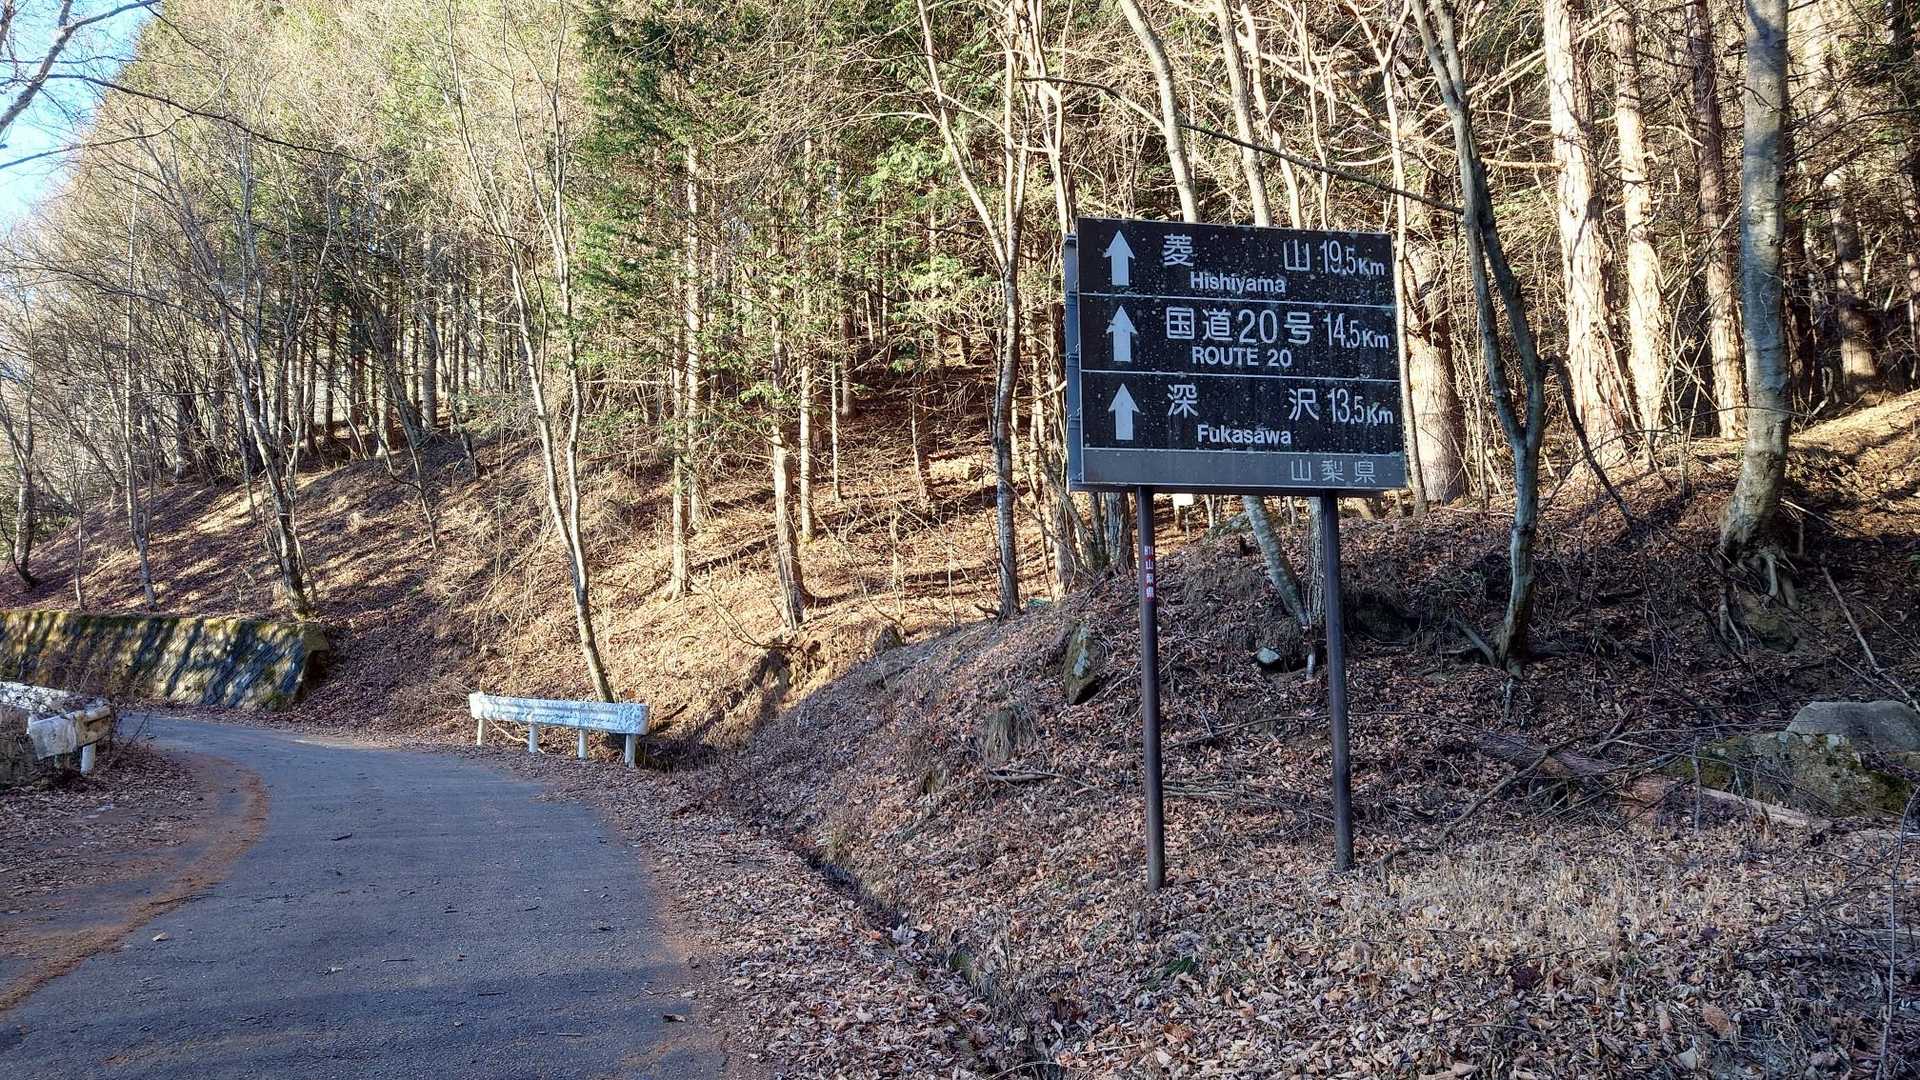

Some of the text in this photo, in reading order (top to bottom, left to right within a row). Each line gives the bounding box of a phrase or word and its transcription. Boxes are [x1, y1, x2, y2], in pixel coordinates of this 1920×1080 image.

[1190, 271, 1286, 295] Hishiyama
[1192, 346, 1292, 367] ROUTE 20
[1197, 424, 1291, 445] Fukasawa
[1290, 459, 1376, 484] 山梨県
